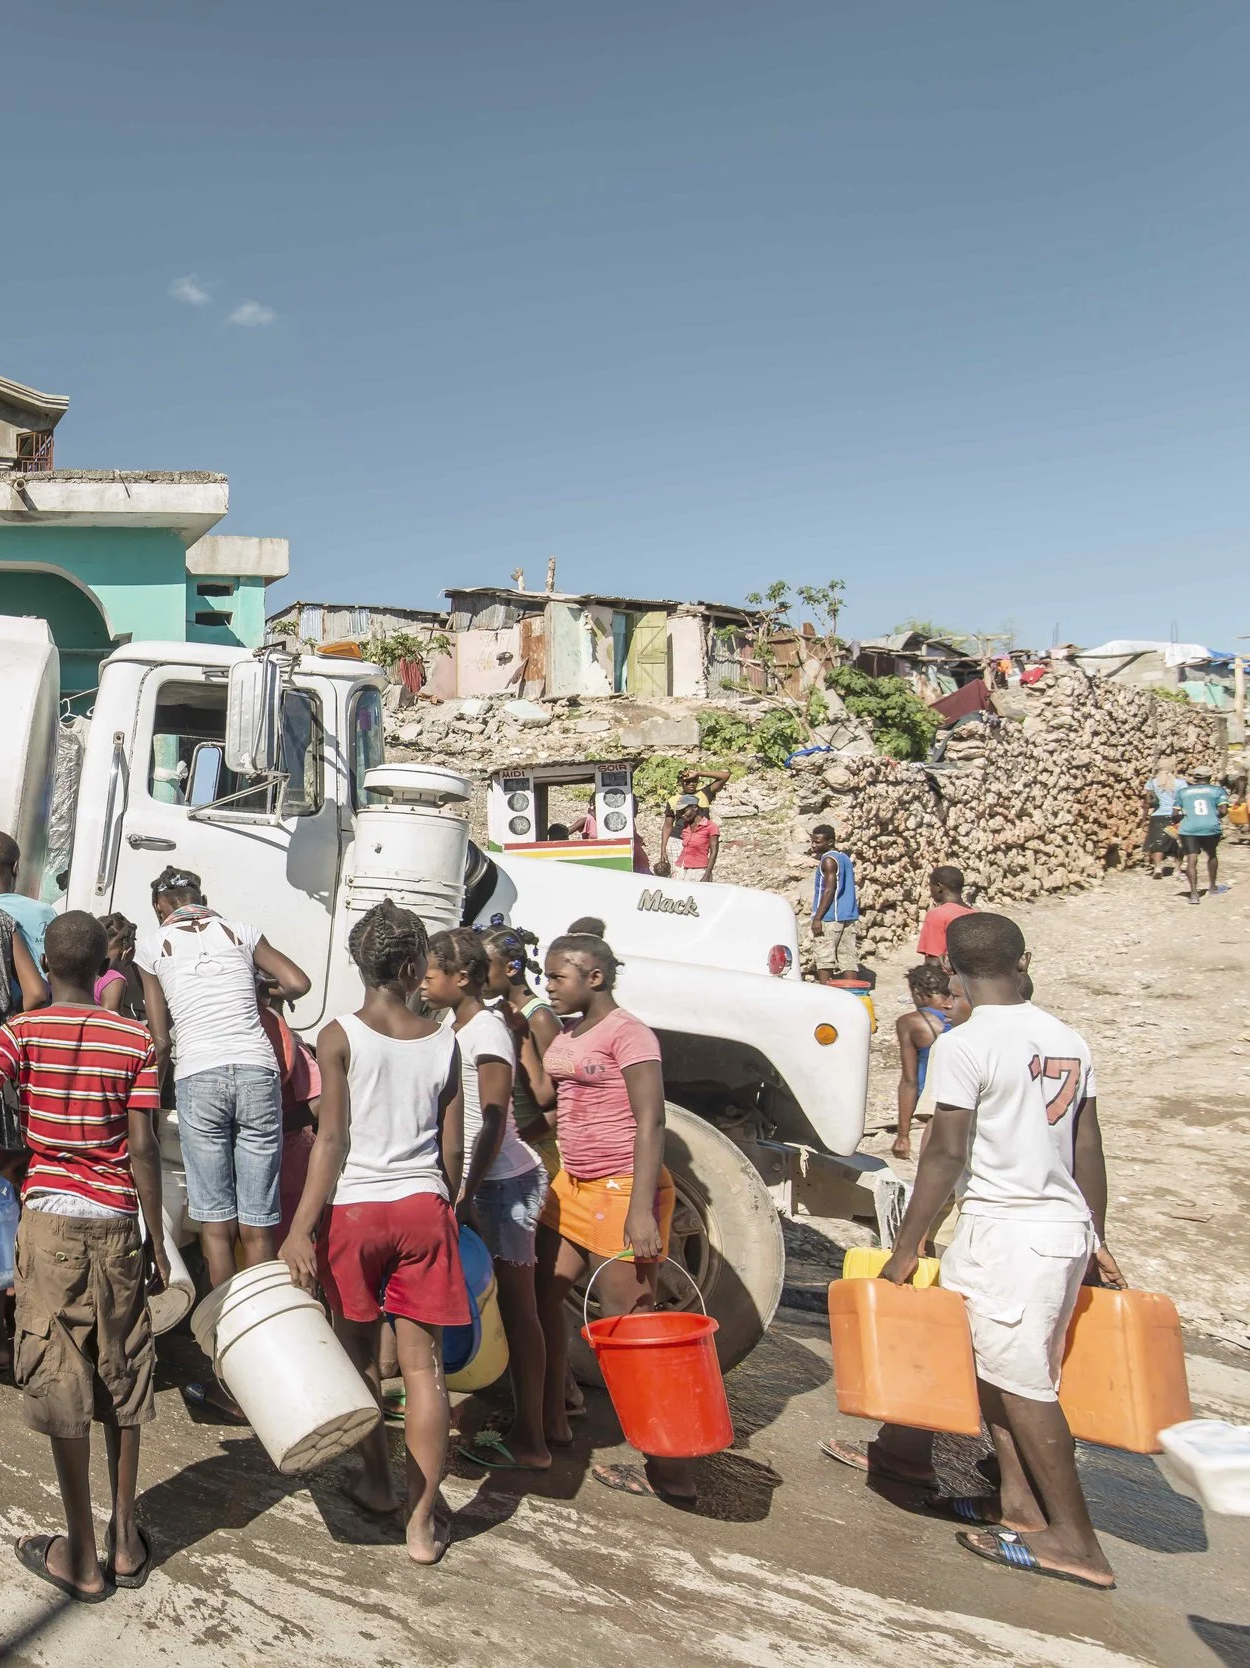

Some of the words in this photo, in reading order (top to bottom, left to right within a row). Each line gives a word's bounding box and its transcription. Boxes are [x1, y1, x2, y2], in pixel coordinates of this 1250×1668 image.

[501, 770, 526, 779] MIDI
[597, 763, 627, 773] SOIR
[1193, 799, 1209, 816] 8
[637, 888, 700, 918] Mack
